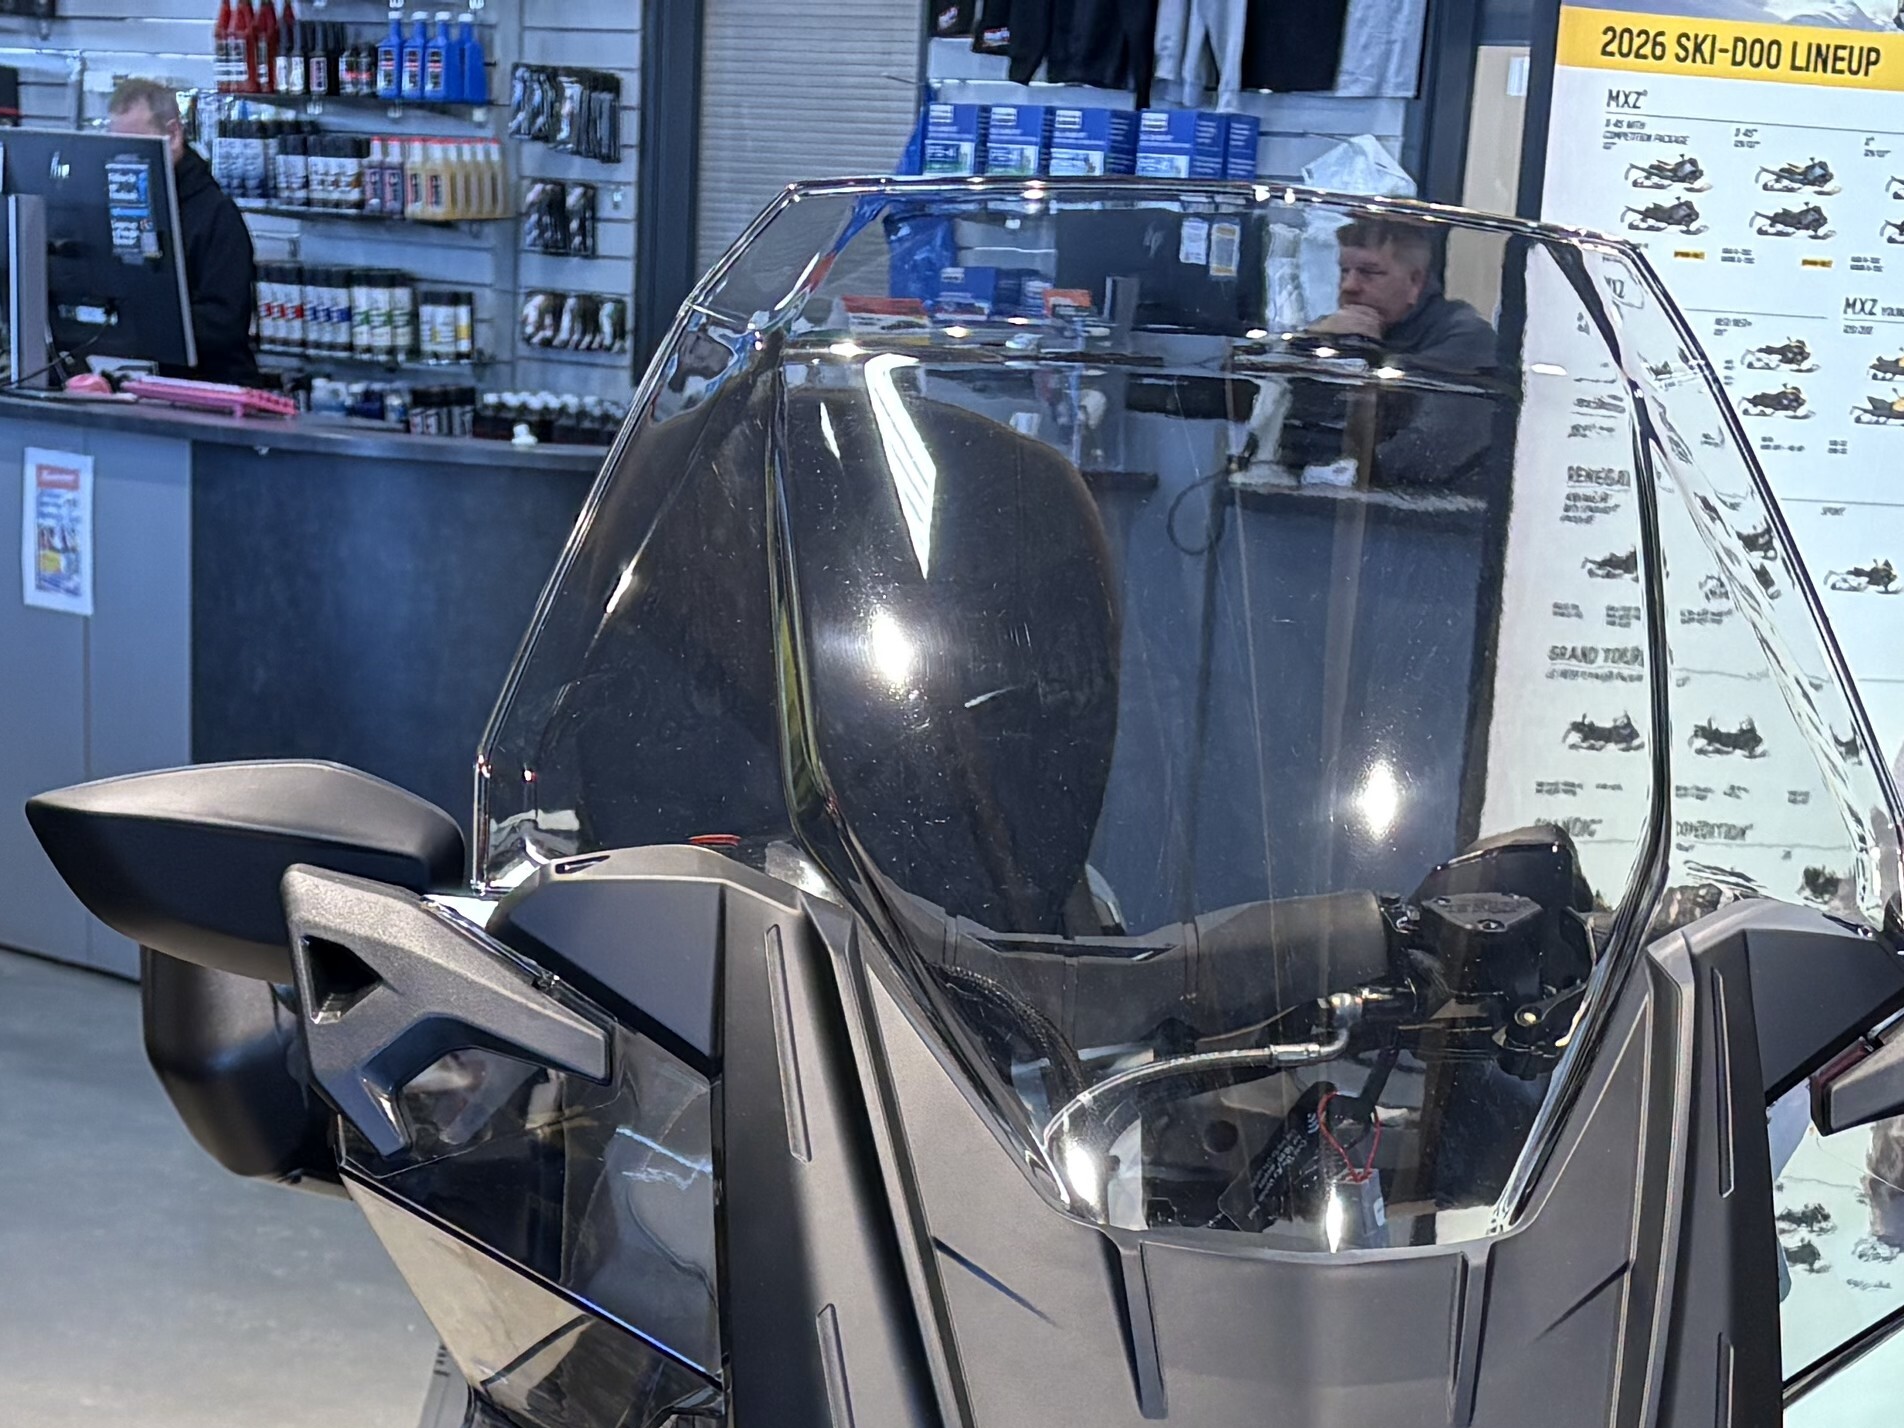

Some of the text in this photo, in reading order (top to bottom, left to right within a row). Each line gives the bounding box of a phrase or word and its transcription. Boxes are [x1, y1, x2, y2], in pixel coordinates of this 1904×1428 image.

[1599, 26, 1881, 77] 2026 SKI-DOO LINEUP
[1843, 297, 1878, 316] MXZ
[1566, 465, 1632, 488] RENEGA
